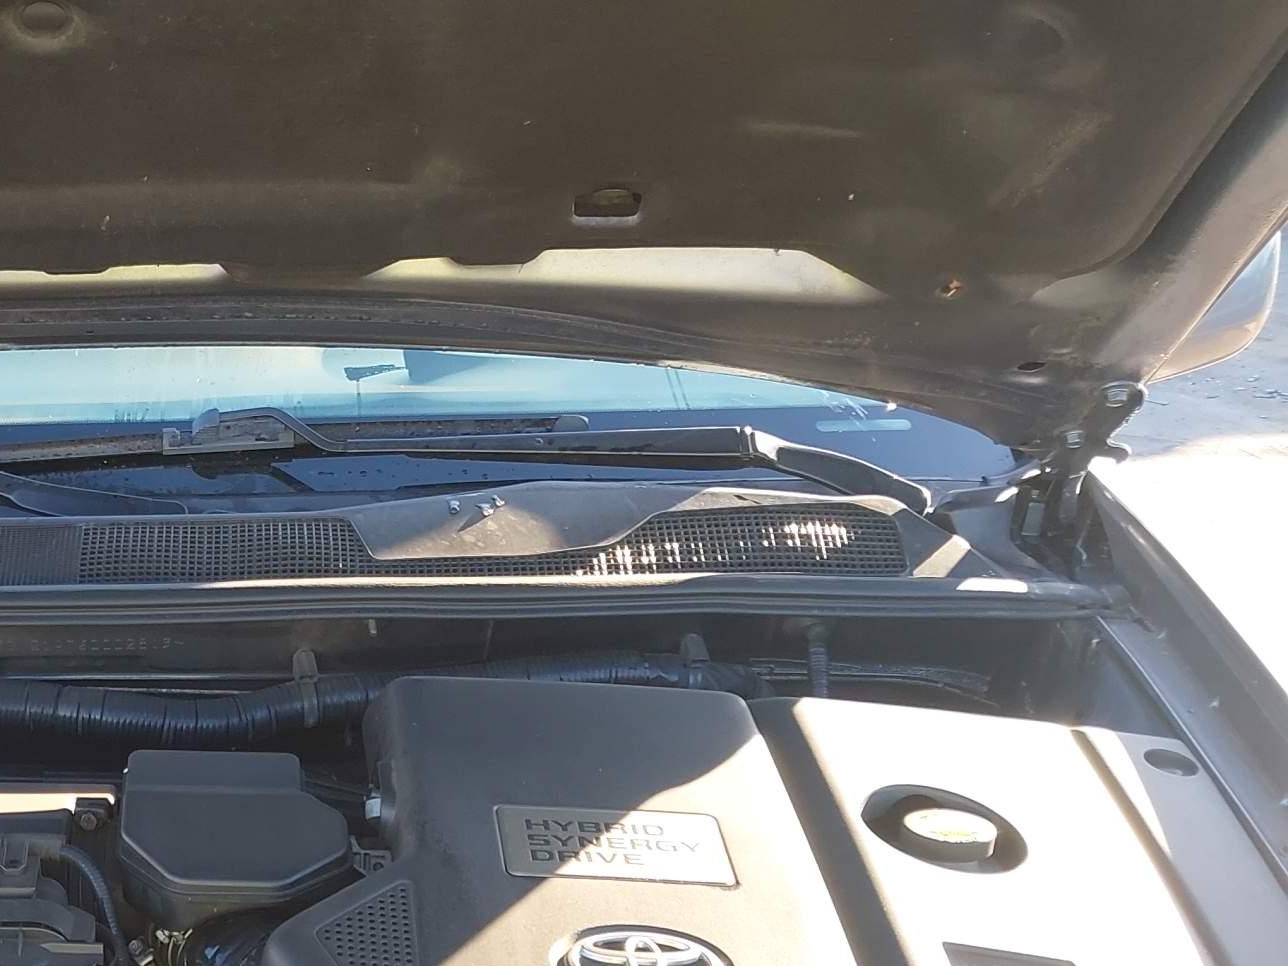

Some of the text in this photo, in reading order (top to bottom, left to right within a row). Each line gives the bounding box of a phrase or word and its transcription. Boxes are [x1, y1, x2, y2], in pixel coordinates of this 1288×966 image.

[525, 819, 665, 836] HYBRID
[527, 833, 701, 853] SYNERGY
[530, 849, 645, 866] DRIVE
